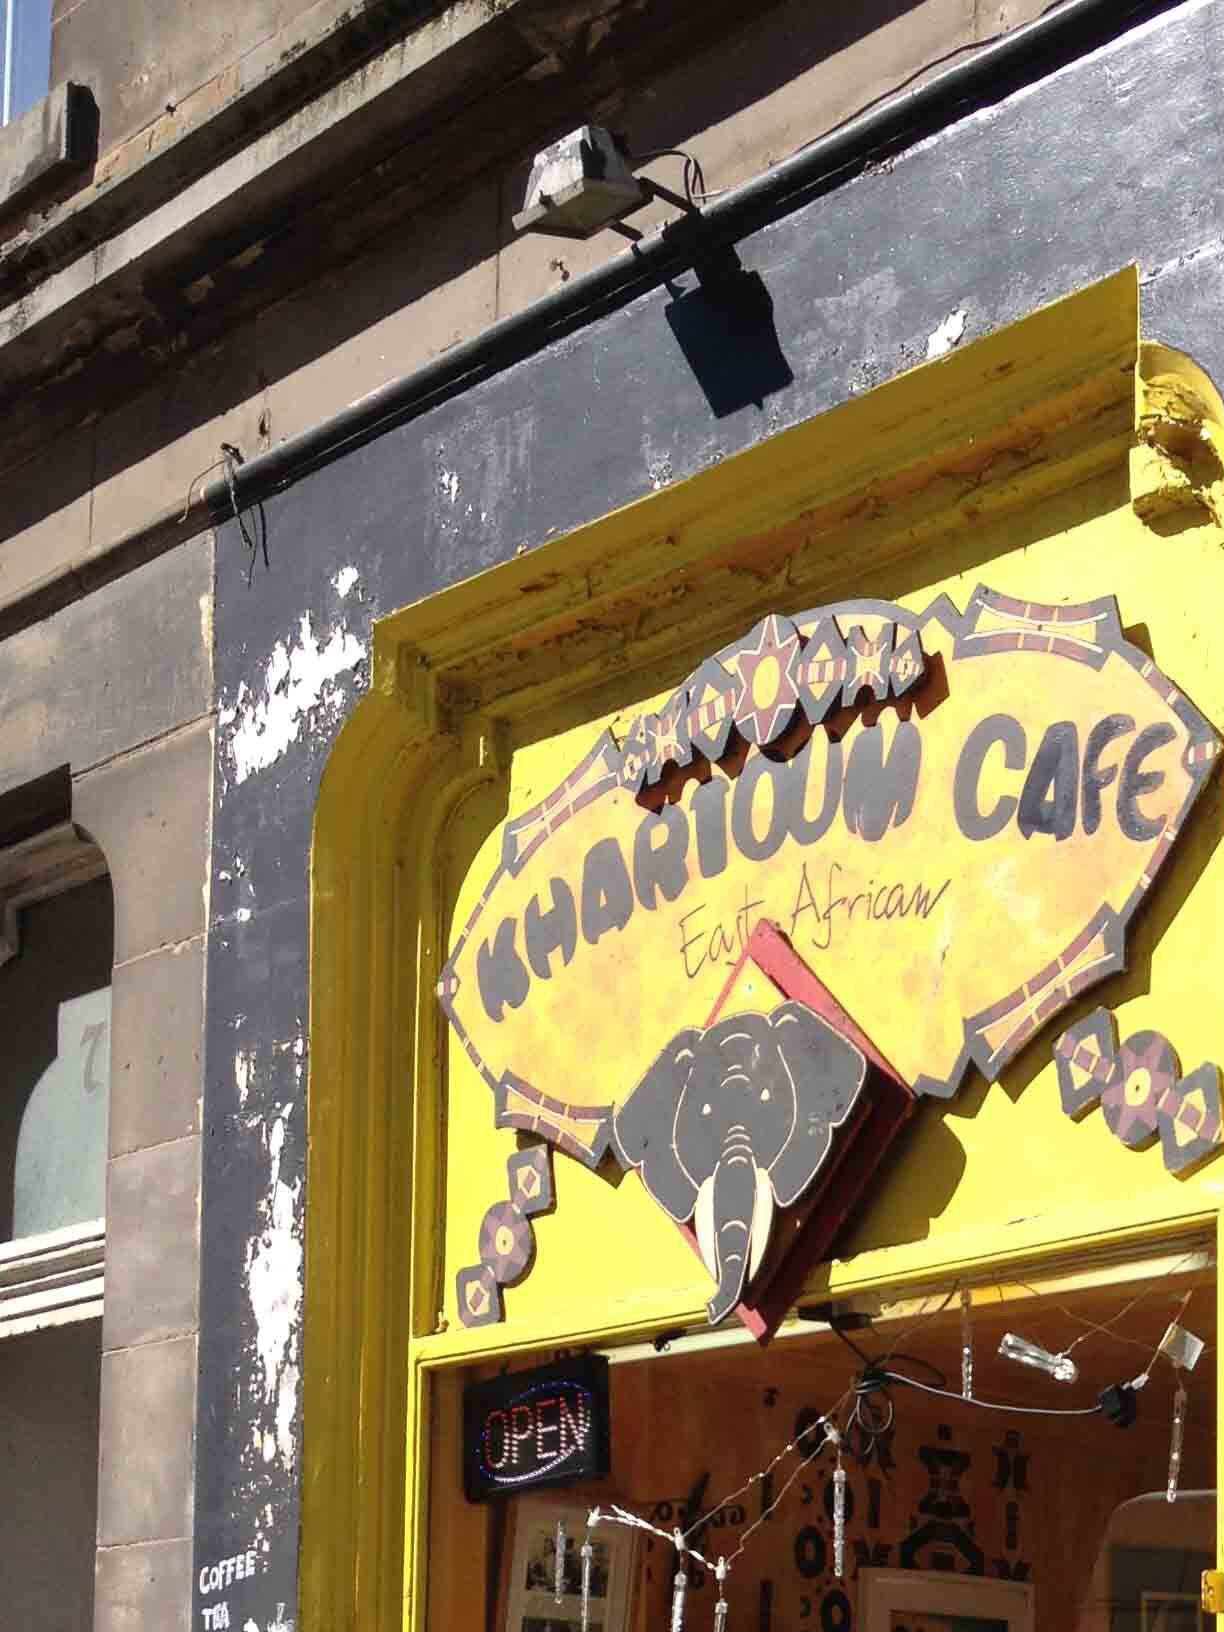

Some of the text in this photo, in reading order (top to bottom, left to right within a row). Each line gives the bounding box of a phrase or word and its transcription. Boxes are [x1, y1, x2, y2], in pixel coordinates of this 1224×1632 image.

[953, 713, 1177, 843] CAFE
[679, 862, 952, 978] East African
[484, 1393, 587, 1468] OPEN
[199, 1550, 257, 1595] COFFEE
[201, 1601, 231, 1631] TEA
